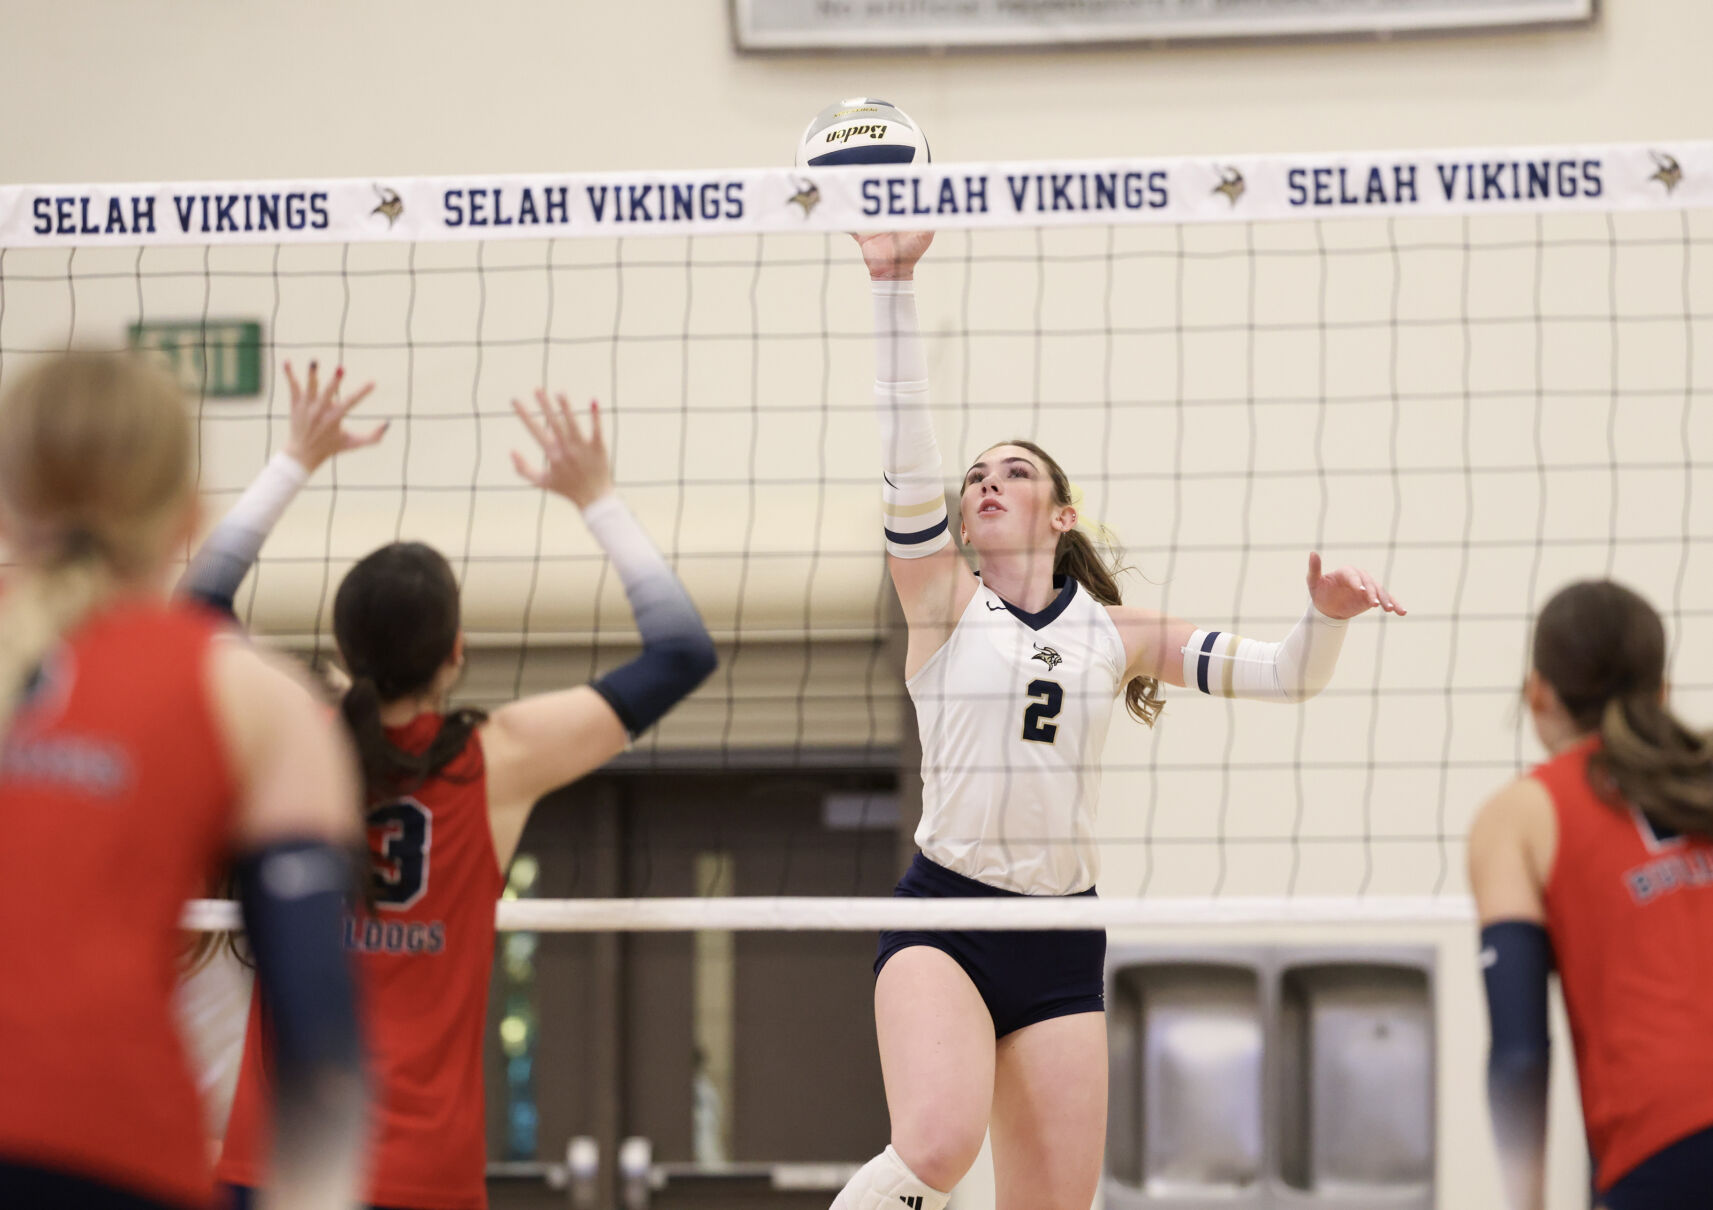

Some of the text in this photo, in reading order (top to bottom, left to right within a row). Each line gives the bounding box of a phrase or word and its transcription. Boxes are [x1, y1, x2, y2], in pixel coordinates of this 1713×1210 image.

[825, 124, 888, 144] Baden
[443, 182, 744, 227] SELAH VIKINGS
[861, 171, 1168, 217] SELAH VIKINGS
[1288, 159, 1603, 207] SELAH VIKINGS
[32, 192, 329, 235] SELAH VIKINGS
[1021, 677, 1067, 746] 2
[366, 796, 433, 911] 3
[342, 917, 447, 955] LDOGS
